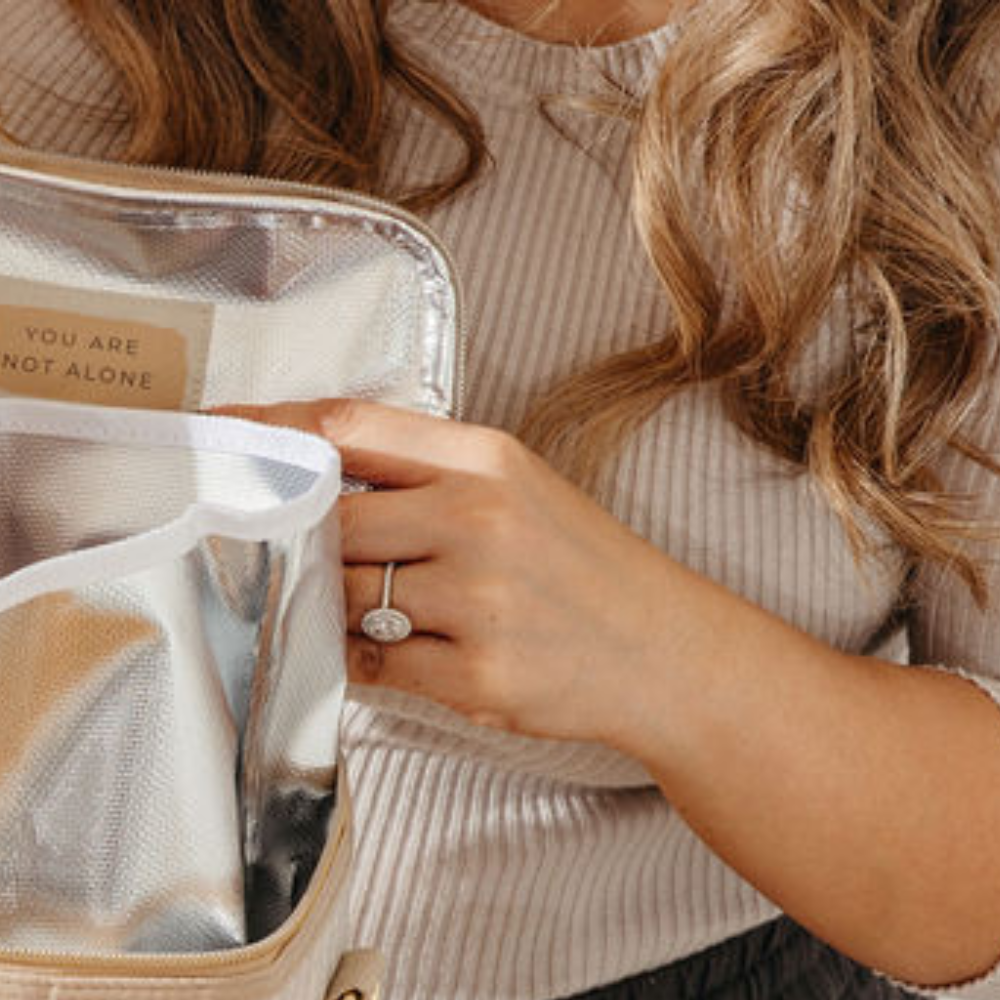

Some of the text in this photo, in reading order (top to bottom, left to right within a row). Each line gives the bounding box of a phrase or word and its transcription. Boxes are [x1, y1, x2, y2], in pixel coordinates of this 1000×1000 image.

[24, 327, 140, 355] YOU ARE
[1, 353, 152, 390] NOT ALONE
